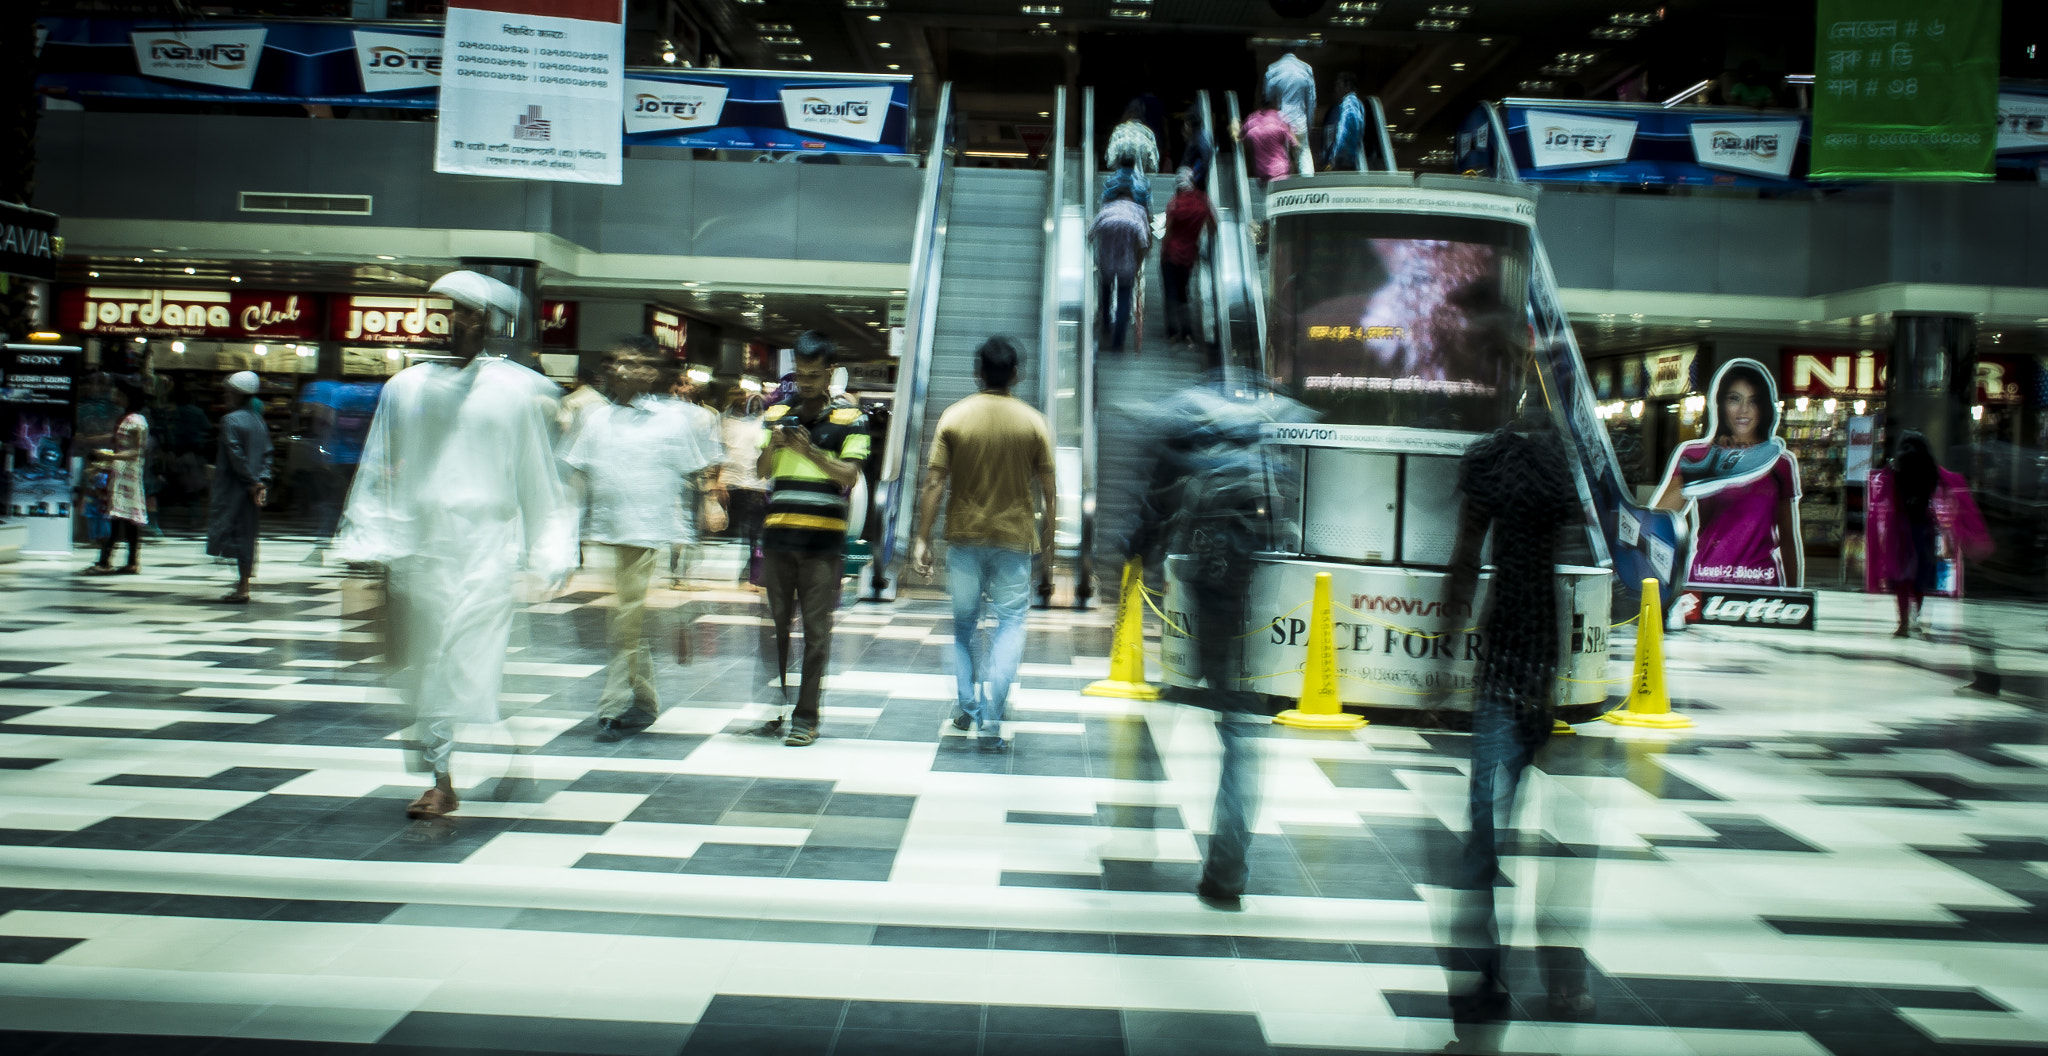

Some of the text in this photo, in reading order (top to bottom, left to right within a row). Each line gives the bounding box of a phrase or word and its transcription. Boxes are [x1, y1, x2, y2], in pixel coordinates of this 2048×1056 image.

[1829, 20, 1898, 38] লেভেল
[1827, 49, 1863, 72] ব্লক
[635, 99, 703, 114] JOTEY
[1545, 131, 1612, 148] JOTEY
[80, 289, 301, 331] jordana Club
[345, 297, 453, 339] jorda
[16, 354, 64, 365] SONY
[1352, 594, 1472, 618] innovision
[1271, 616, 1374, 651] SPCE
[1382, 624, 1454, 660] FOR
